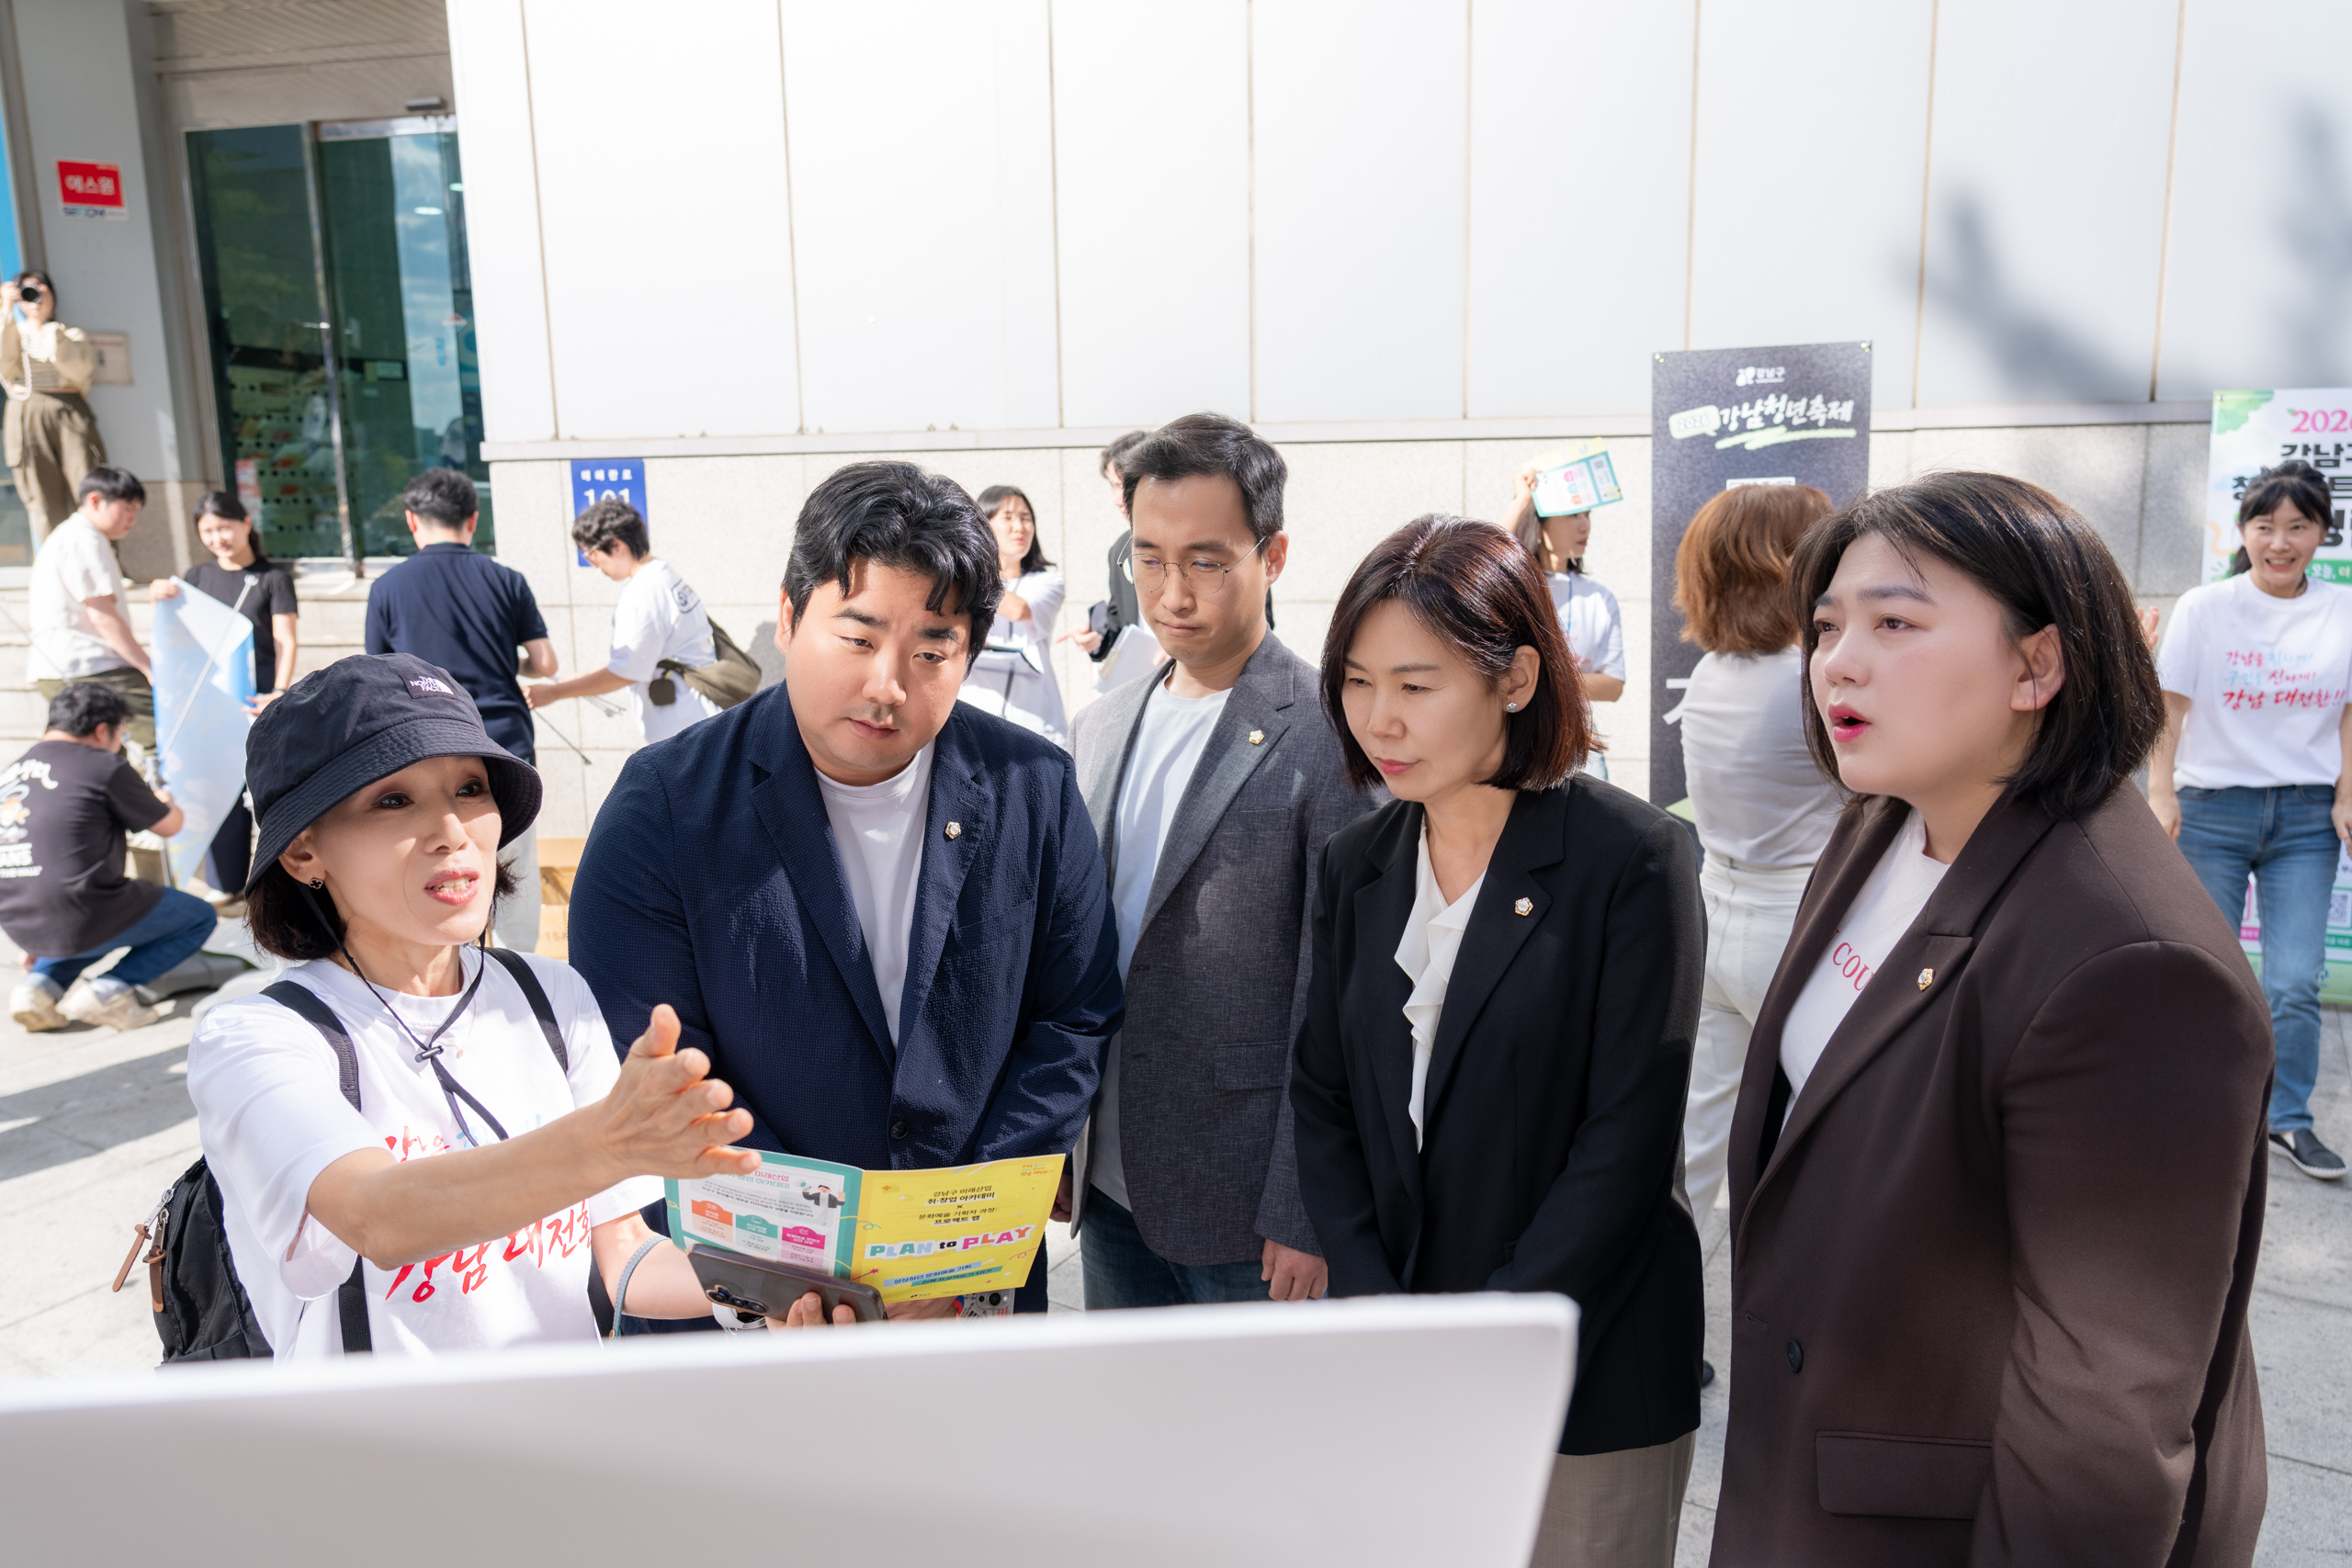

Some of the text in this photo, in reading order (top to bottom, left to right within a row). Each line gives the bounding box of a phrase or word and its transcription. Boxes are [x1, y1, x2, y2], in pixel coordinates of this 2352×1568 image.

[64, 175, 116, 196] 에스원
[2280, 443, 2352, 469] 강남
[2225, 650, 2264, 667] 강남을
[2222, 687, 2346, 711] 강남 대전환!!
[754, 1170, 789, 1182] 미래산업
[755, 1178, 790, 1189] 아카데미
[927, 1191, 996, 1204] 취·창업 아카데미
[933, 1185, 992, 1198] 강남구 미래산업
[919, 1212, 951, 1220] 문화예술
[933, 1216, 969, 1225] 프로젝트
[870, 1226, 1032, 1258] PLAN to PLAY
